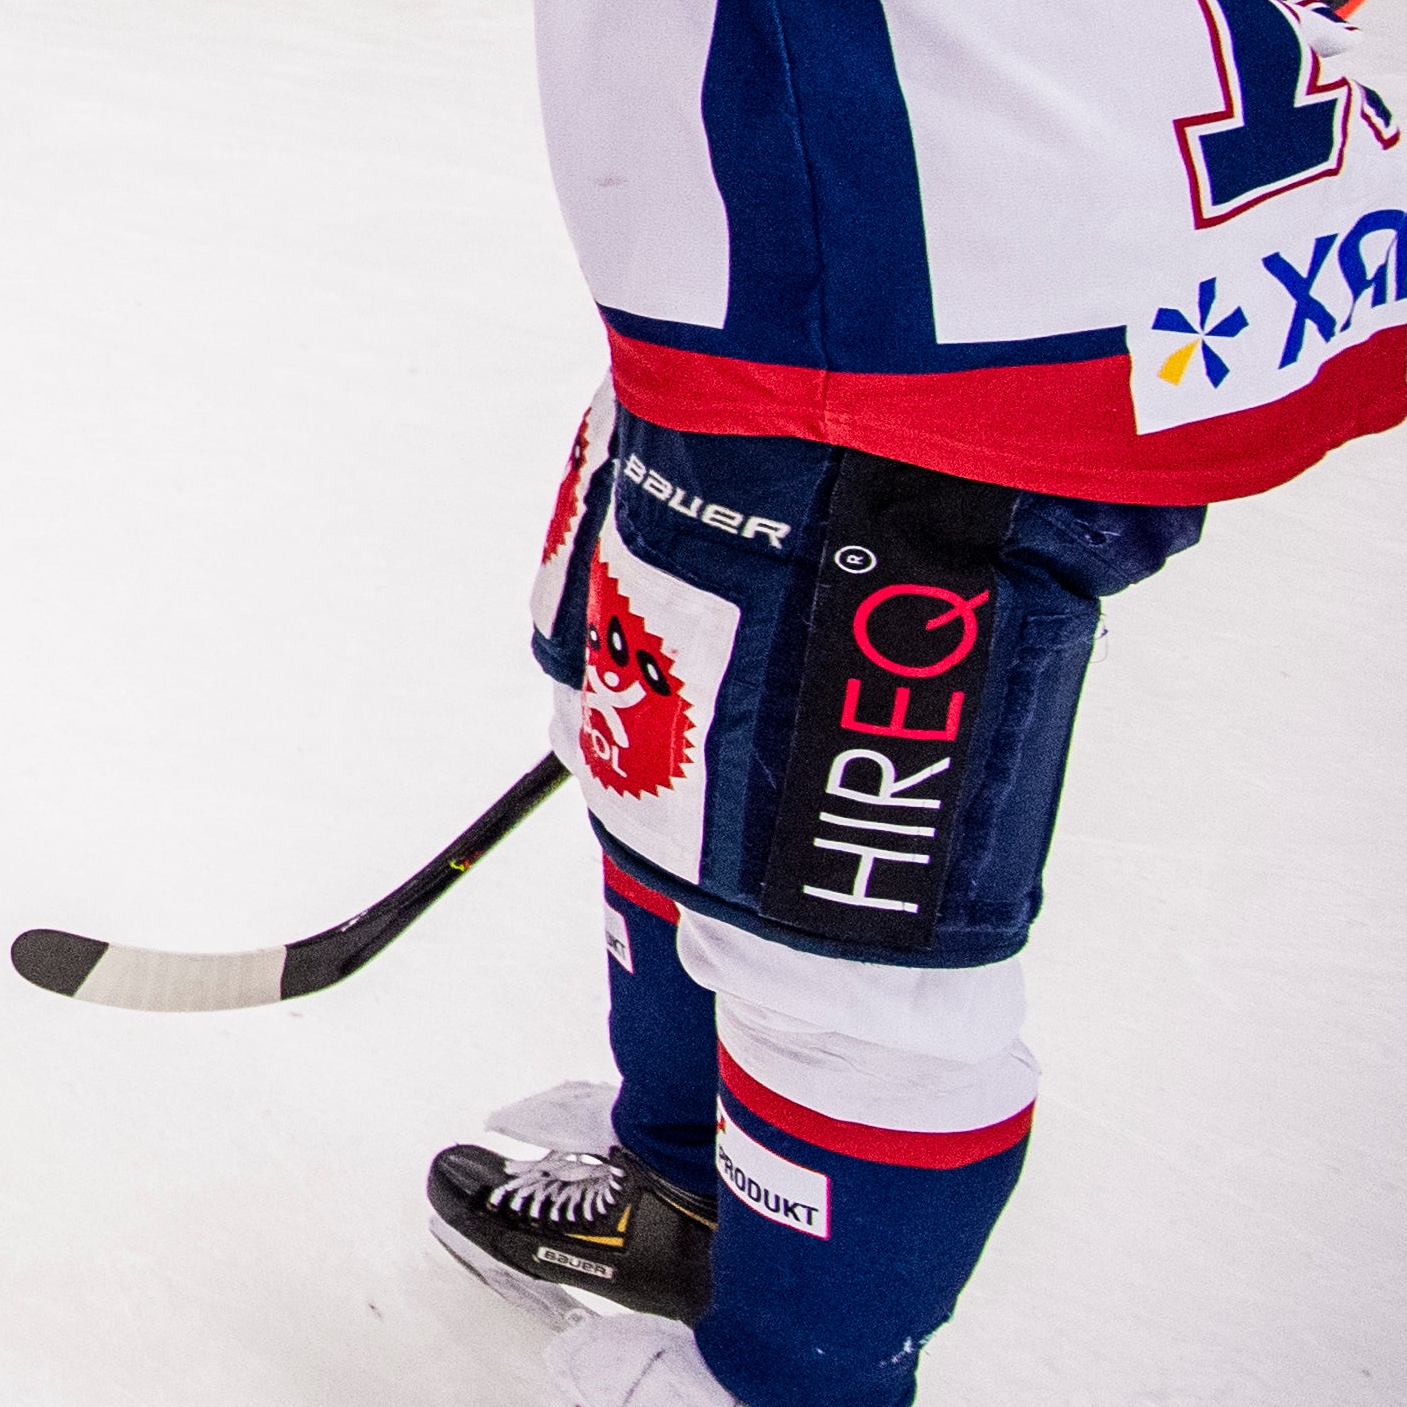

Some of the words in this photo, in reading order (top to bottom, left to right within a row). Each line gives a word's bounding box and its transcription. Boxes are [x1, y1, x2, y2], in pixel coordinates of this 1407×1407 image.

[623, 453, 792, 550] BAUER
[802, 583, 989, 915] HIREQ
[716, 1143, 820, 1228] PRODUKT
[541, 1247, 609, 1277] BAUER
